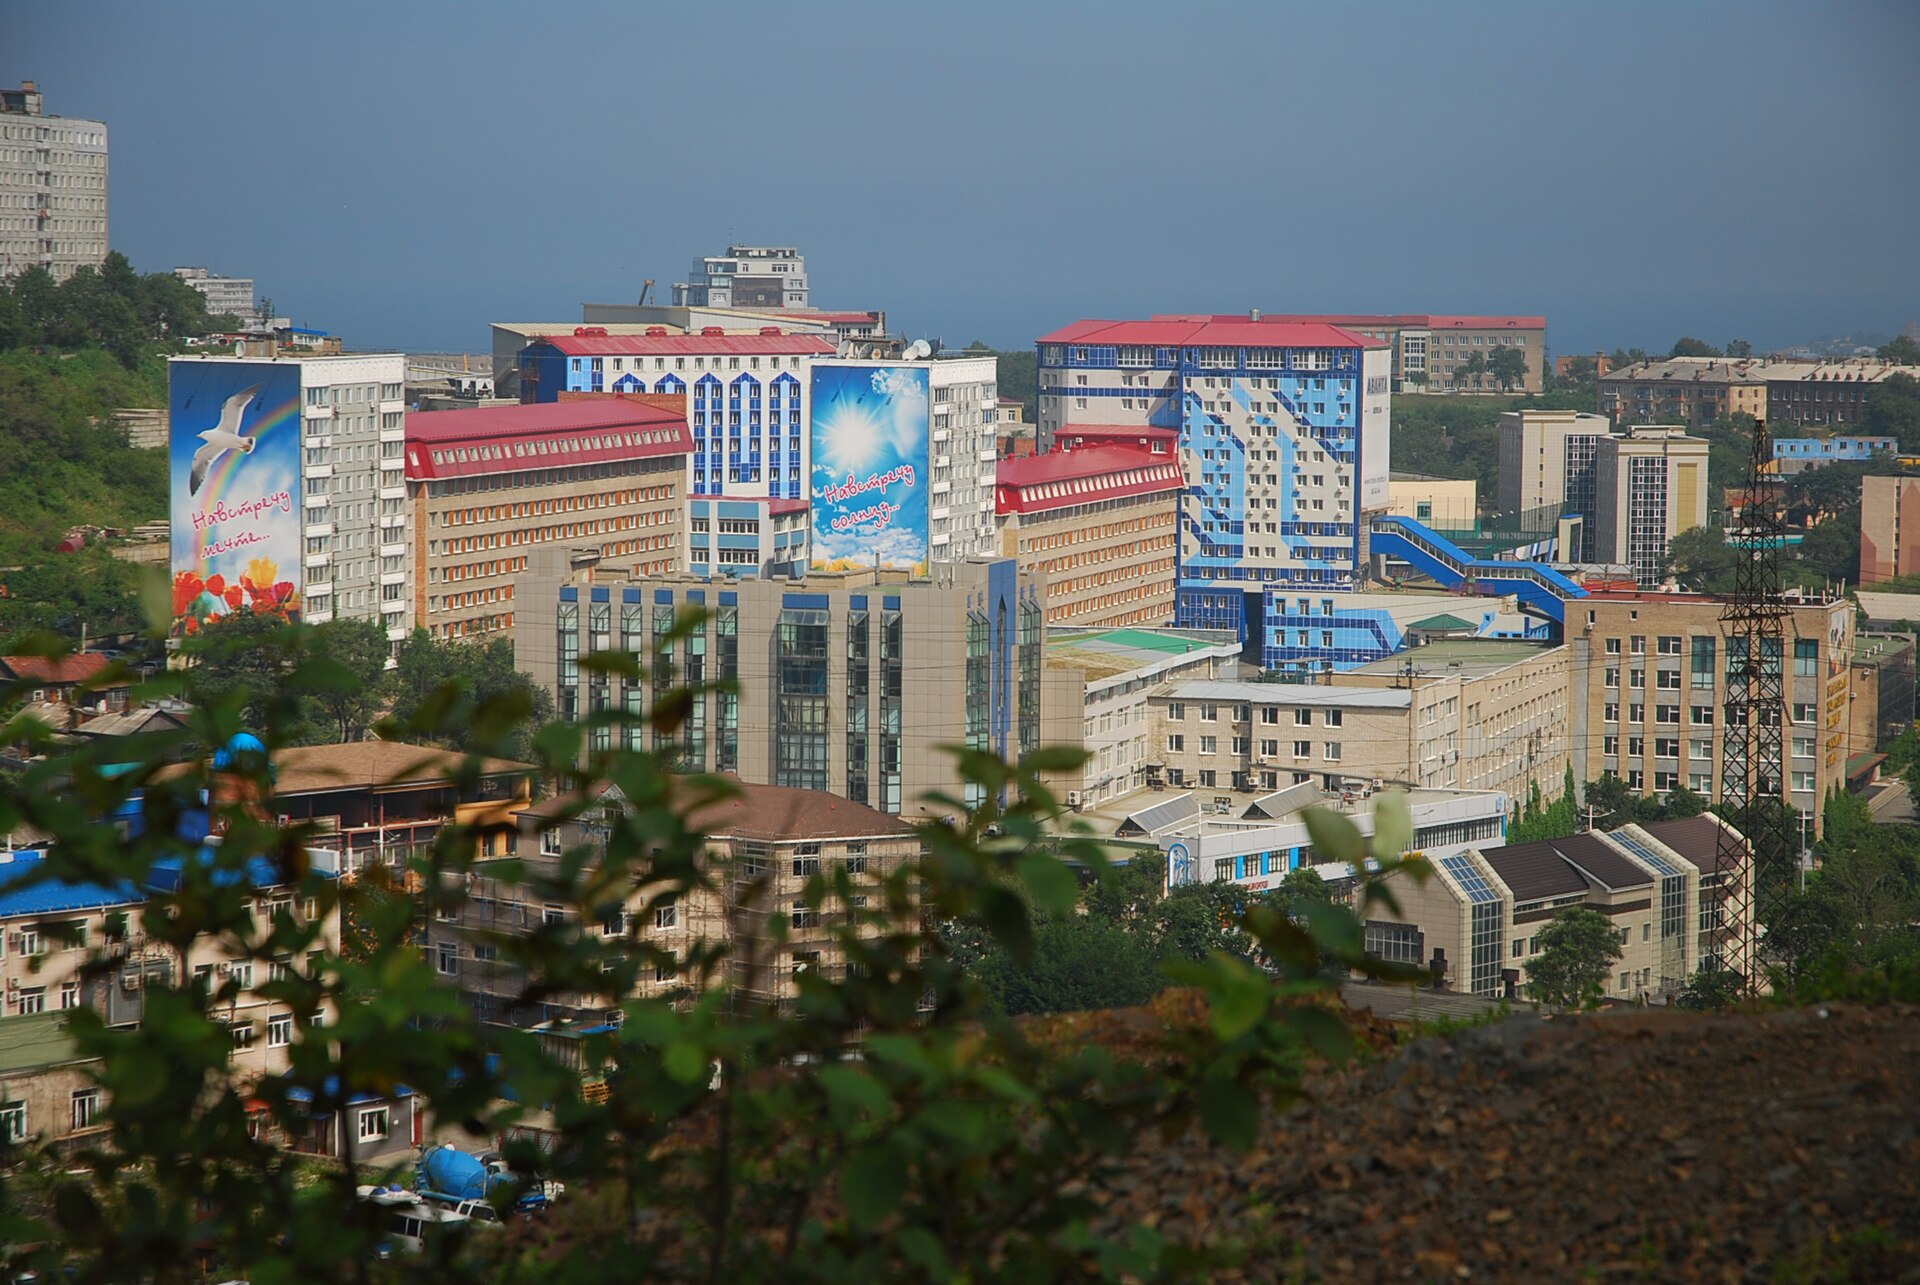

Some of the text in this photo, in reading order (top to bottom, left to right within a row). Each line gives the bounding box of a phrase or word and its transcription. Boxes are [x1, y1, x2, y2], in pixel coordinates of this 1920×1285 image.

[824, 465, 914, 503] Навстречу
[191, 491, 290, 529] Навстречу
[831, 501, 900, 529] солнцу...
